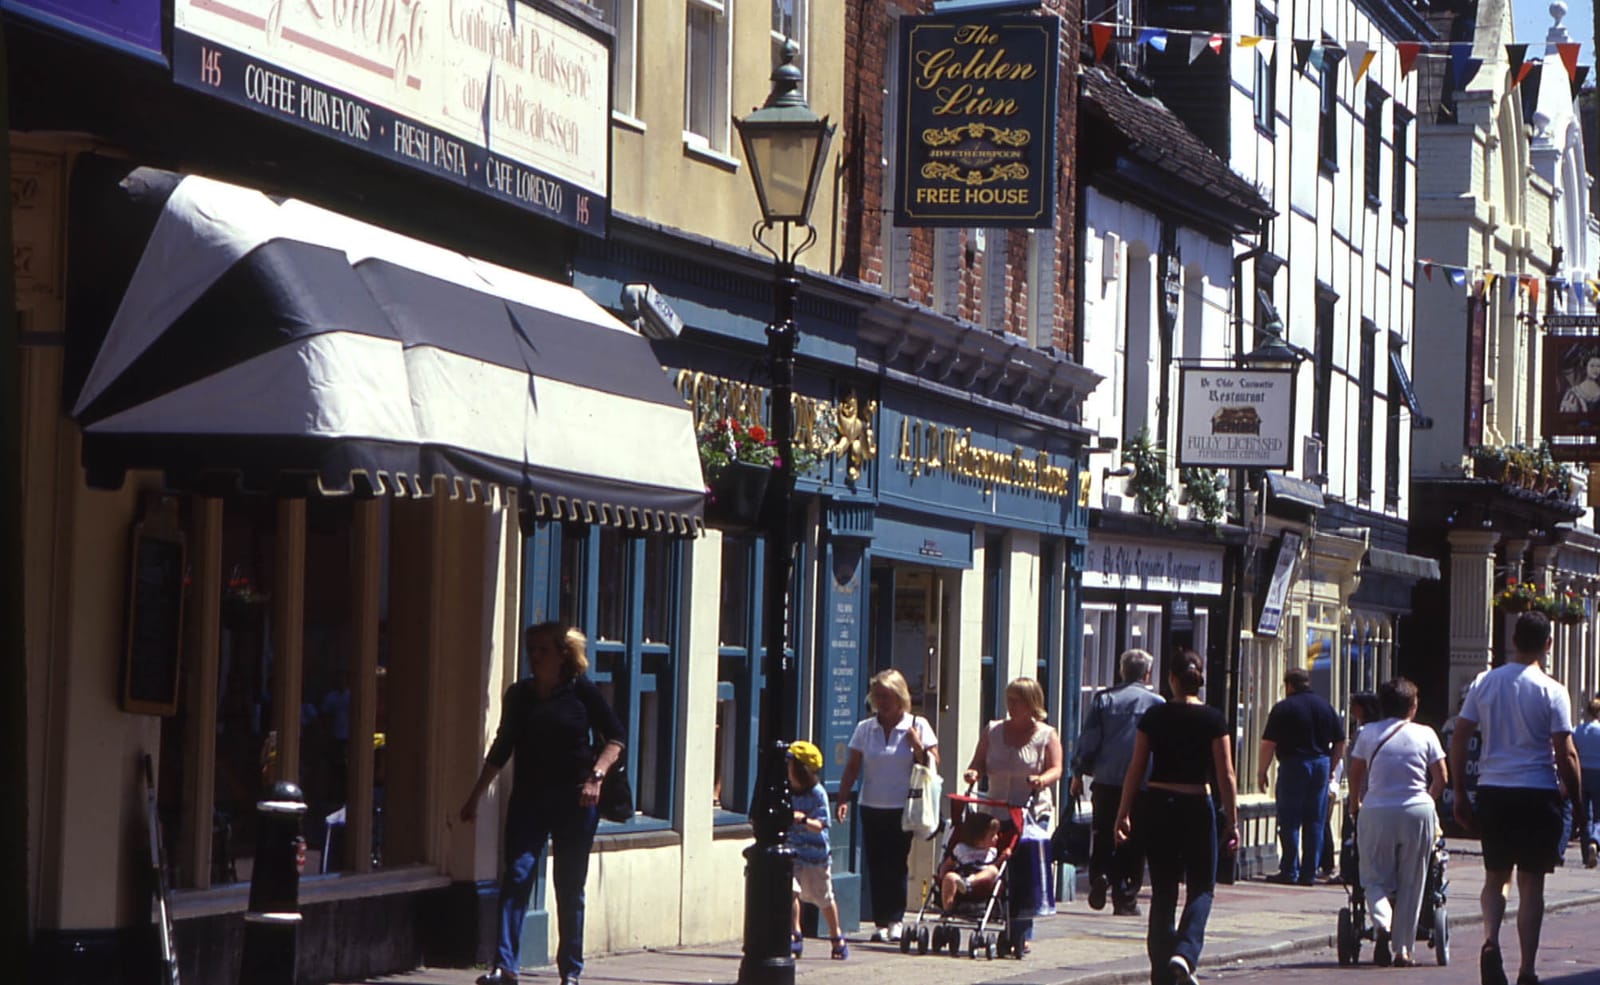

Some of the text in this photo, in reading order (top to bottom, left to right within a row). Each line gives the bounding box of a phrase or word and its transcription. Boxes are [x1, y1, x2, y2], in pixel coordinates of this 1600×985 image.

[953, 24, 999, 45] The
[449, 0, 591, 100] Continental Patisserie
[915, 48, 1037, 90] Golden
[932, 84, 1019, 116] Lion
[495, 74, 579, 156] Delicatessen
[201, 47, 589, 224] 145 COFFEE PURVEYORS FRESH PASTA CAFE LORENZO 145
[916, 188, 1029, 204] FREE HOUSE
[1208, 389, 1265, 403] Restaurant
[1215, 377, 1234, 389] Olde
[1188, 435, 1283, 452] FULLY LICENSED
